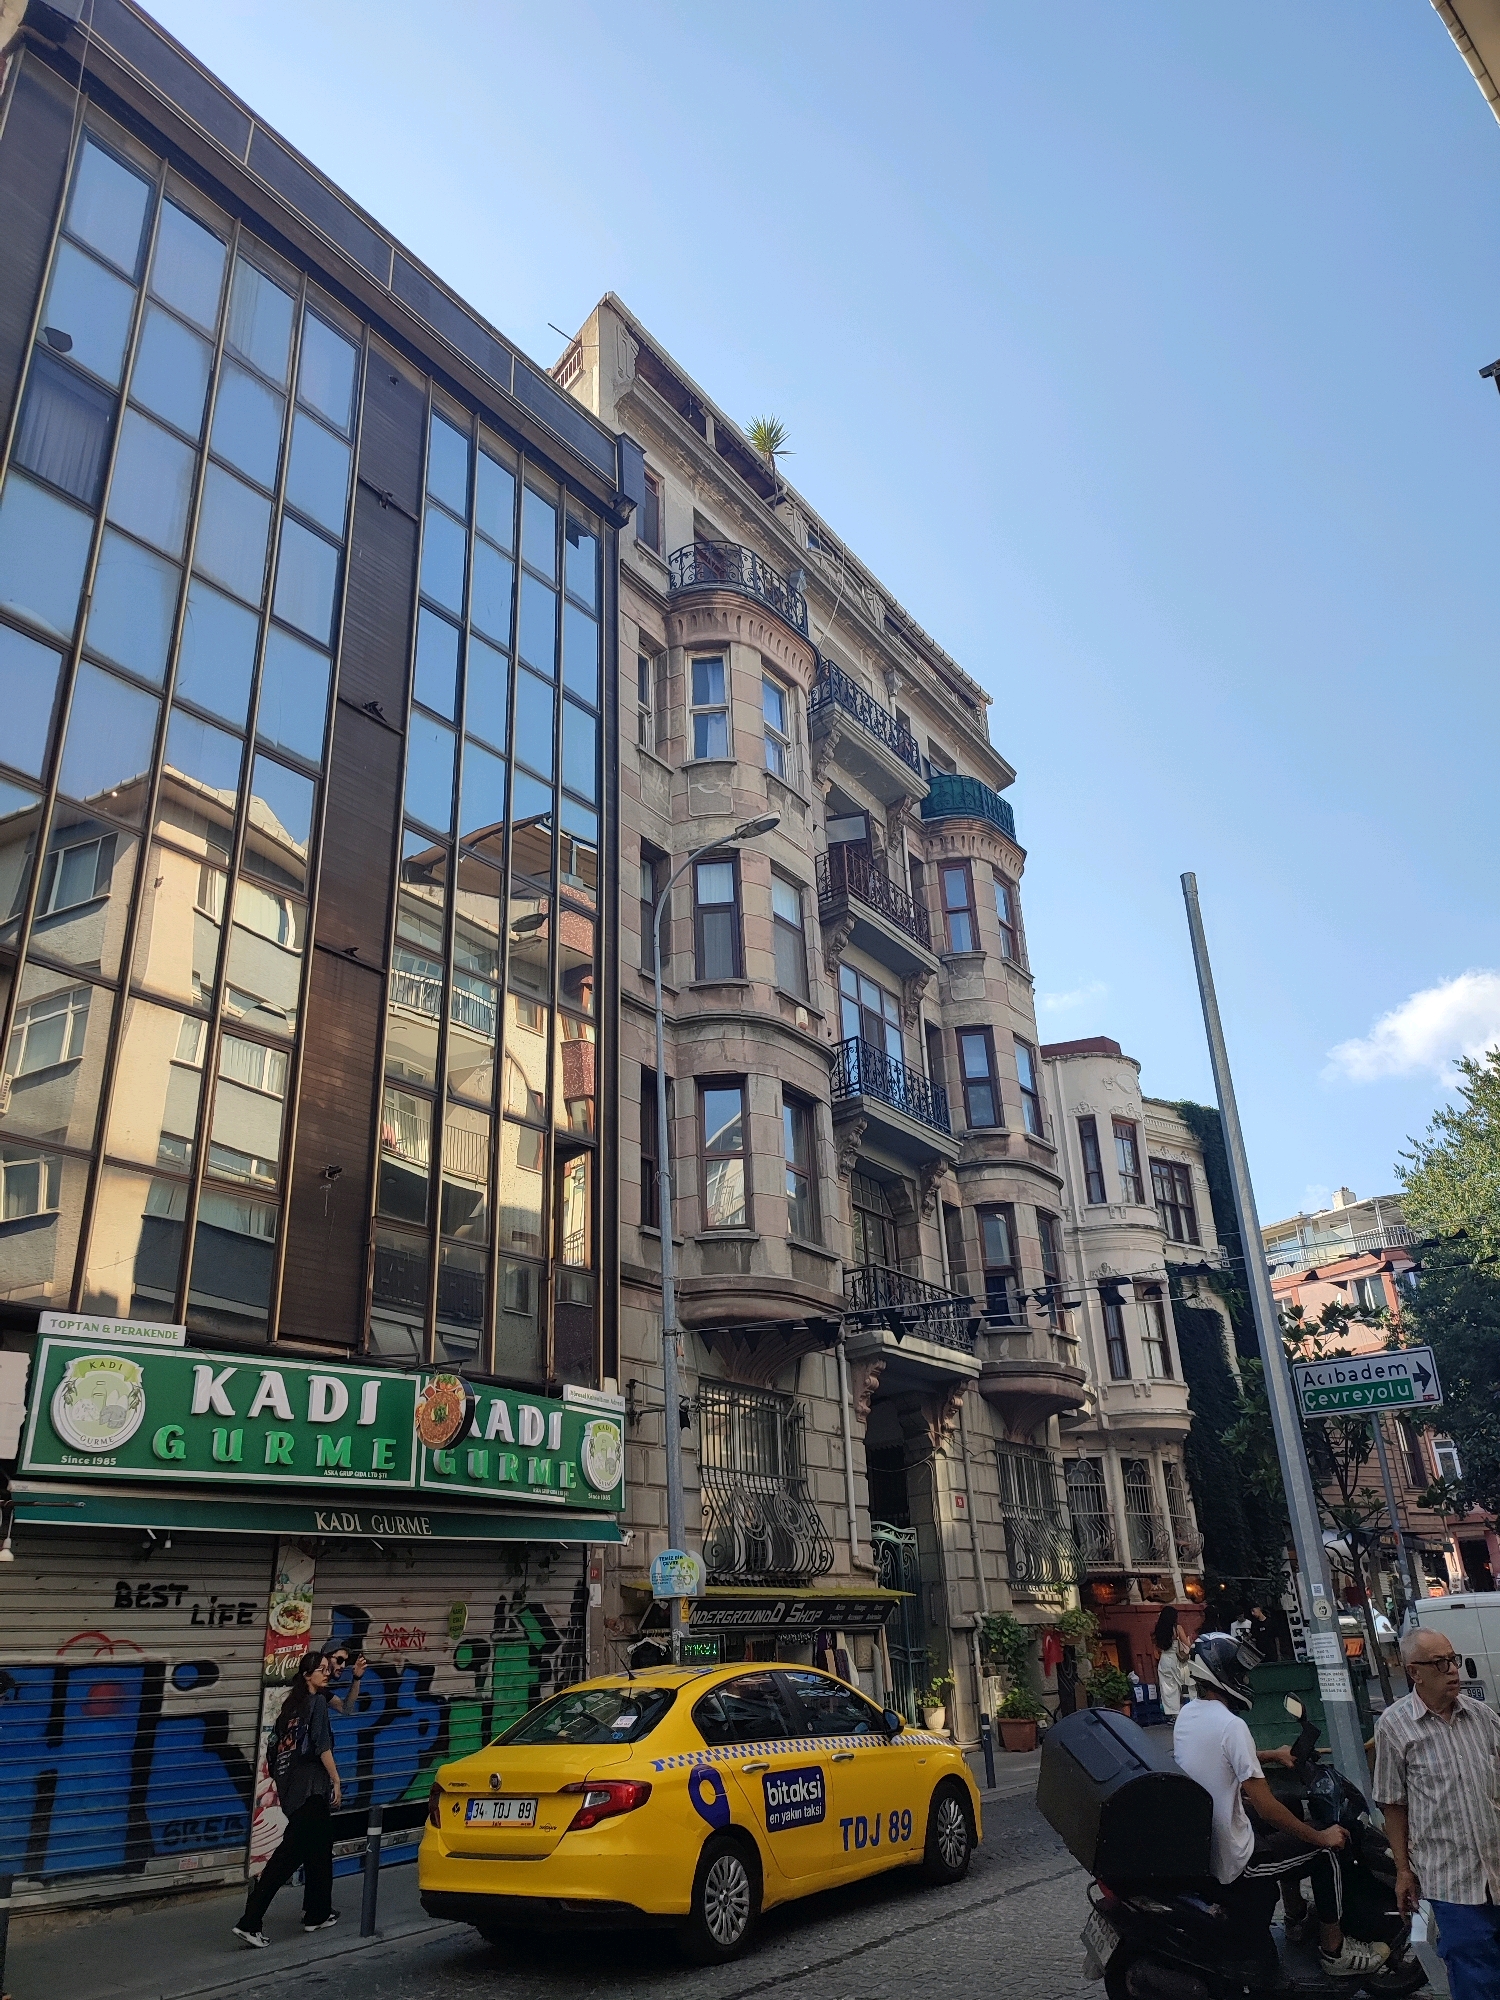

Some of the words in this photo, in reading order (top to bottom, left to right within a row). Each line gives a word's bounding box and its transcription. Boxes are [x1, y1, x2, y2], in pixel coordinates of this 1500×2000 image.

[50, 1318, 99, 1333] TOPTAN
[102, 1324, 112, 1334] &
[114, 1325, 179, 1341] PERAKENDE
[89, 1361, 124, 1371] KADI
[1303, 1363, 1408, 1387] Acıbadem
[190, 1364, 382, 1425] KADI
[1304, 1382, 1410, 1409] Çevreyolu
[80, 1434, 114, 1446] GURME
[152, 1424, 397, 1471] GURME
[61, 1455, 89, 1465] Since
[92, 1456, 117, 1466] 1985
[433, 1448, 577, 1489] GURME
[354, 1470, 367, 1478] GIDA
[314, 1511, 363, 1532] KADI
[371, 1514, 432, 1535] GURME
[114, 1581, 189, 1608] BEST
[766, 1774, 822, 1807] bitaksi
[472, 1802, 484, 1819] 34
[492, 1801, 511, 1819] TDJ
[517, 1802, 532, 1819] 89
[769, 1813, 780, 1825] en
[781, 1808, 802, 1825] yakın
[803, 1802, 822, 1818] taksi
[839, 1812, 882, 1852] TDJ
[888, 1808, 912, 1844] 89
